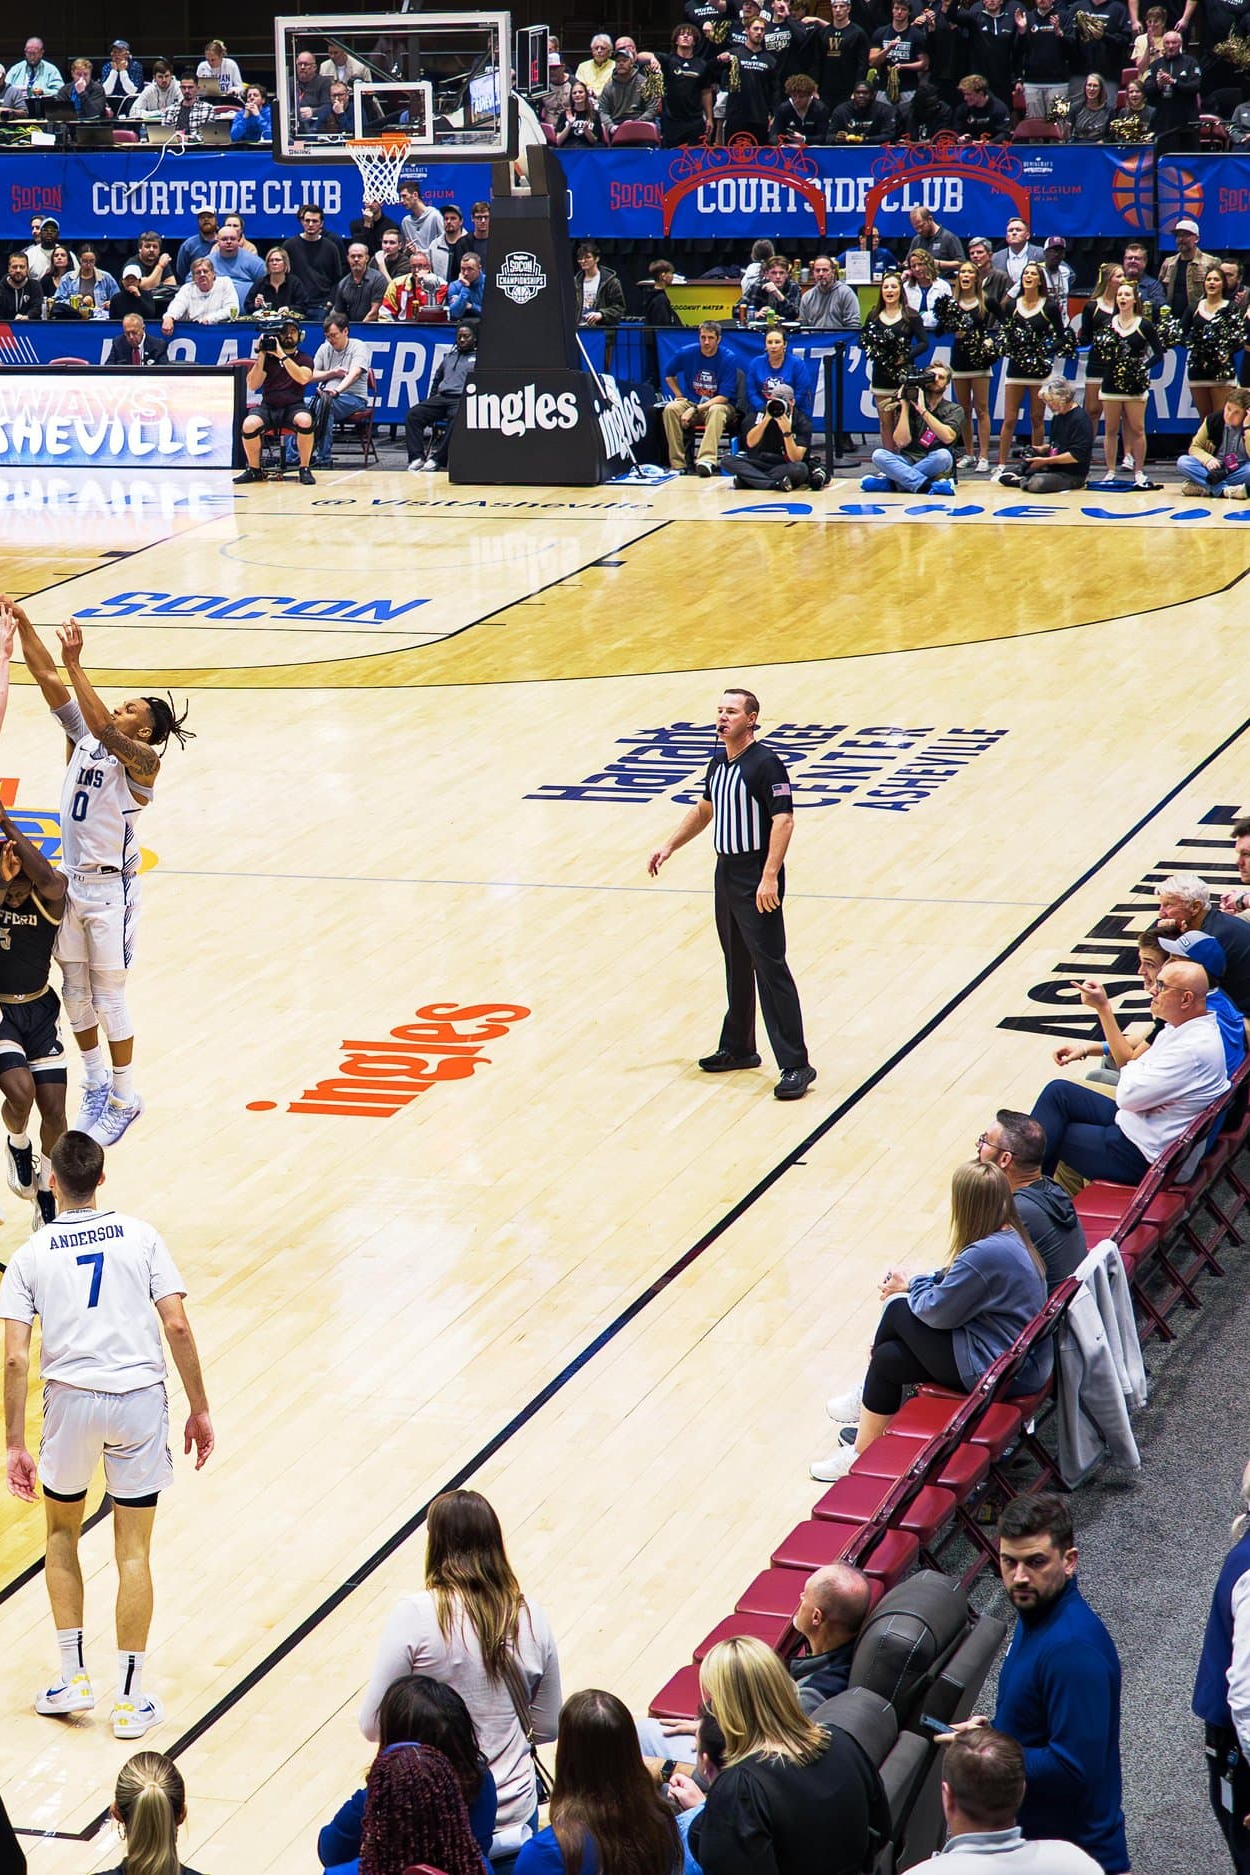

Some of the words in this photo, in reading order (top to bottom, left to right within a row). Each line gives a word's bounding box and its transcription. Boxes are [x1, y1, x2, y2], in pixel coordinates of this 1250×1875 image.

[92, 181, 257, 215] COURTSIDE
[262, 180, 342, 215] CLUB
[466, 384, 579, 436] ingles
[853, 727, 1010, 812] ASHEVILLE
[71, 791, 89, 822] 0
[245, 1002, 531, 1118] ingles
[49, 1225, 124, 1250] ANDERSON
[76, 1252, 104, 1309] 7
